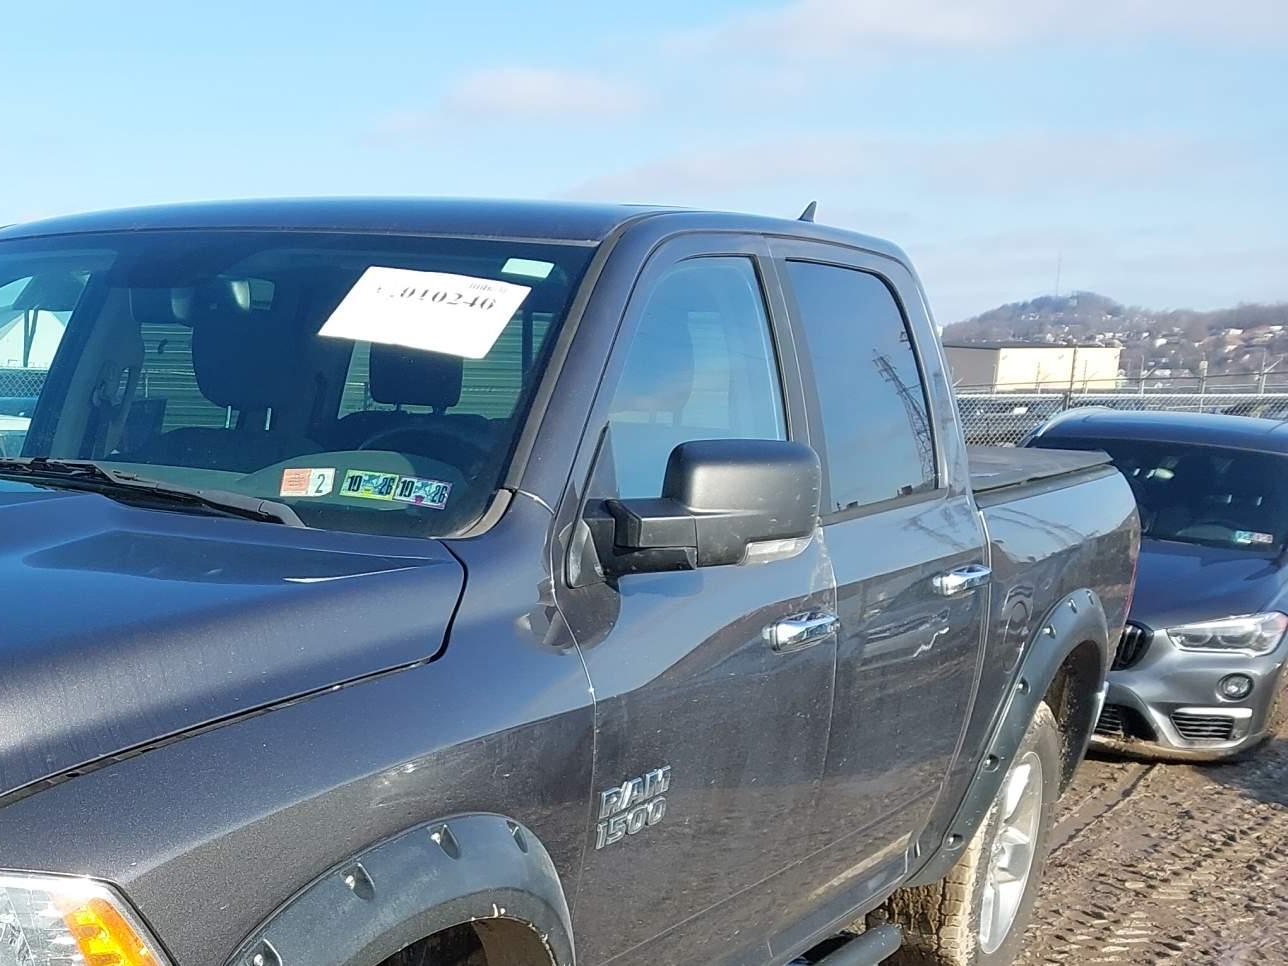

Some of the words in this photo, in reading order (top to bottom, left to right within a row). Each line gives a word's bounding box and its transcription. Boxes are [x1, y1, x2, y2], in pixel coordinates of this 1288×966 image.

[314, 473, 326, 494] 2
[347, 474, 363, 493] 10
[378, 476, 395, 496] 26
[398, 478, 415, 498] 10
[431, 484, 448, 504] 26
[599, 765, 671, 820] RAM
[596, 796, 667, 850] 1500
